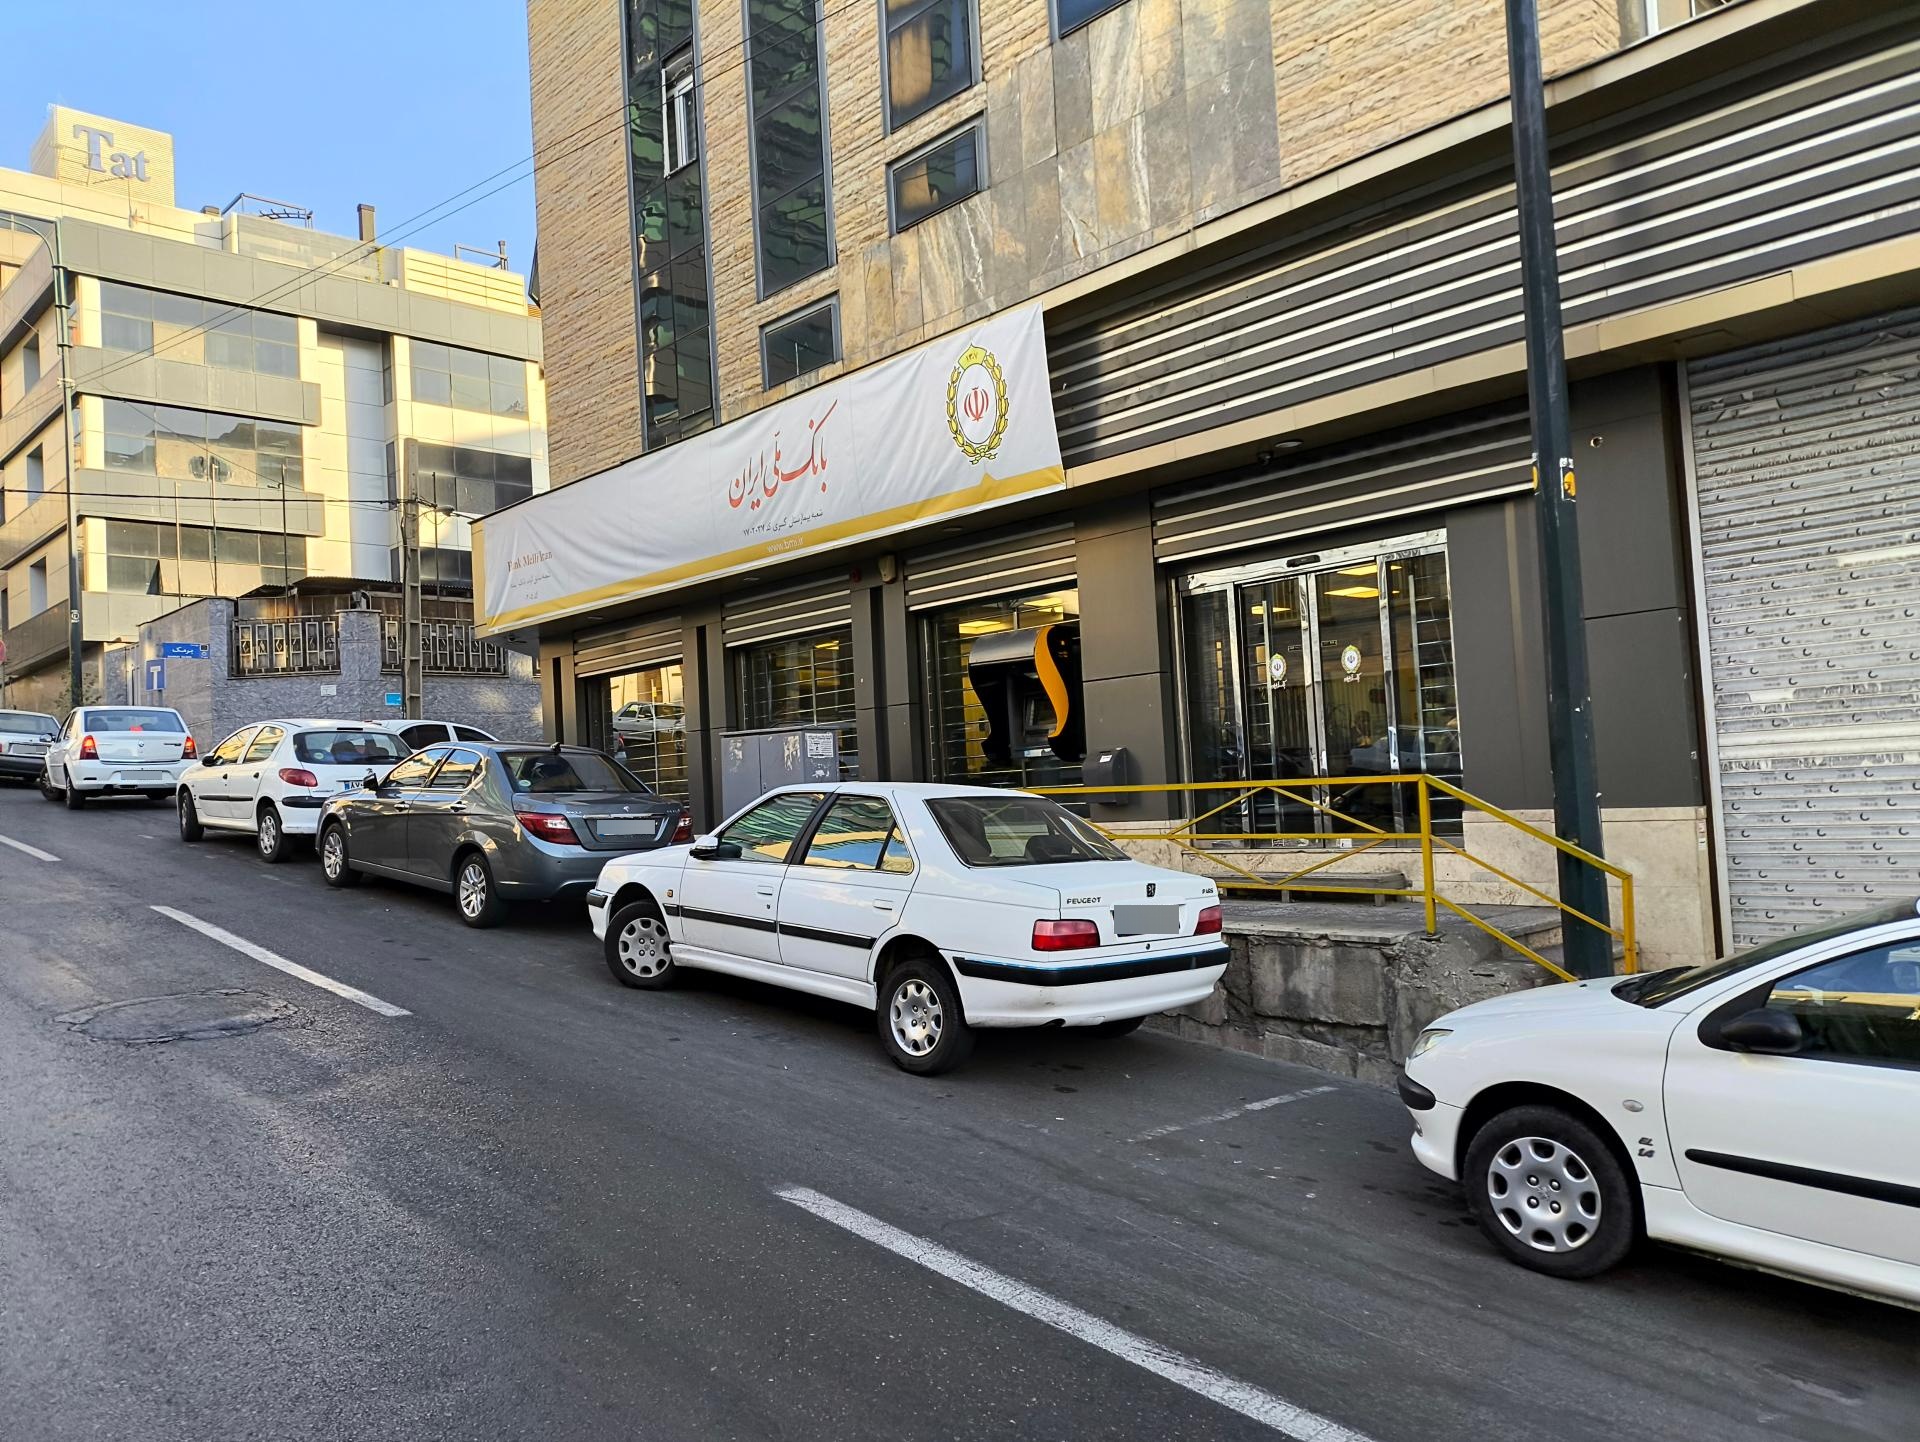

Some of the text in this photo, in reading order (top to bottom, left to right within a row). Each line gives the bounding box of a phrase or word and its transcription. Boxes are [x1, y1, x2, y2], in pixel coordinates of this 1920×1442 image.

[73, 124, 151, 182] Tat
[781, 399, 837, 493] بانک
[729, 450, 763, 511] ایران
[1066, 897, 1101, 905] PEUGEOT
